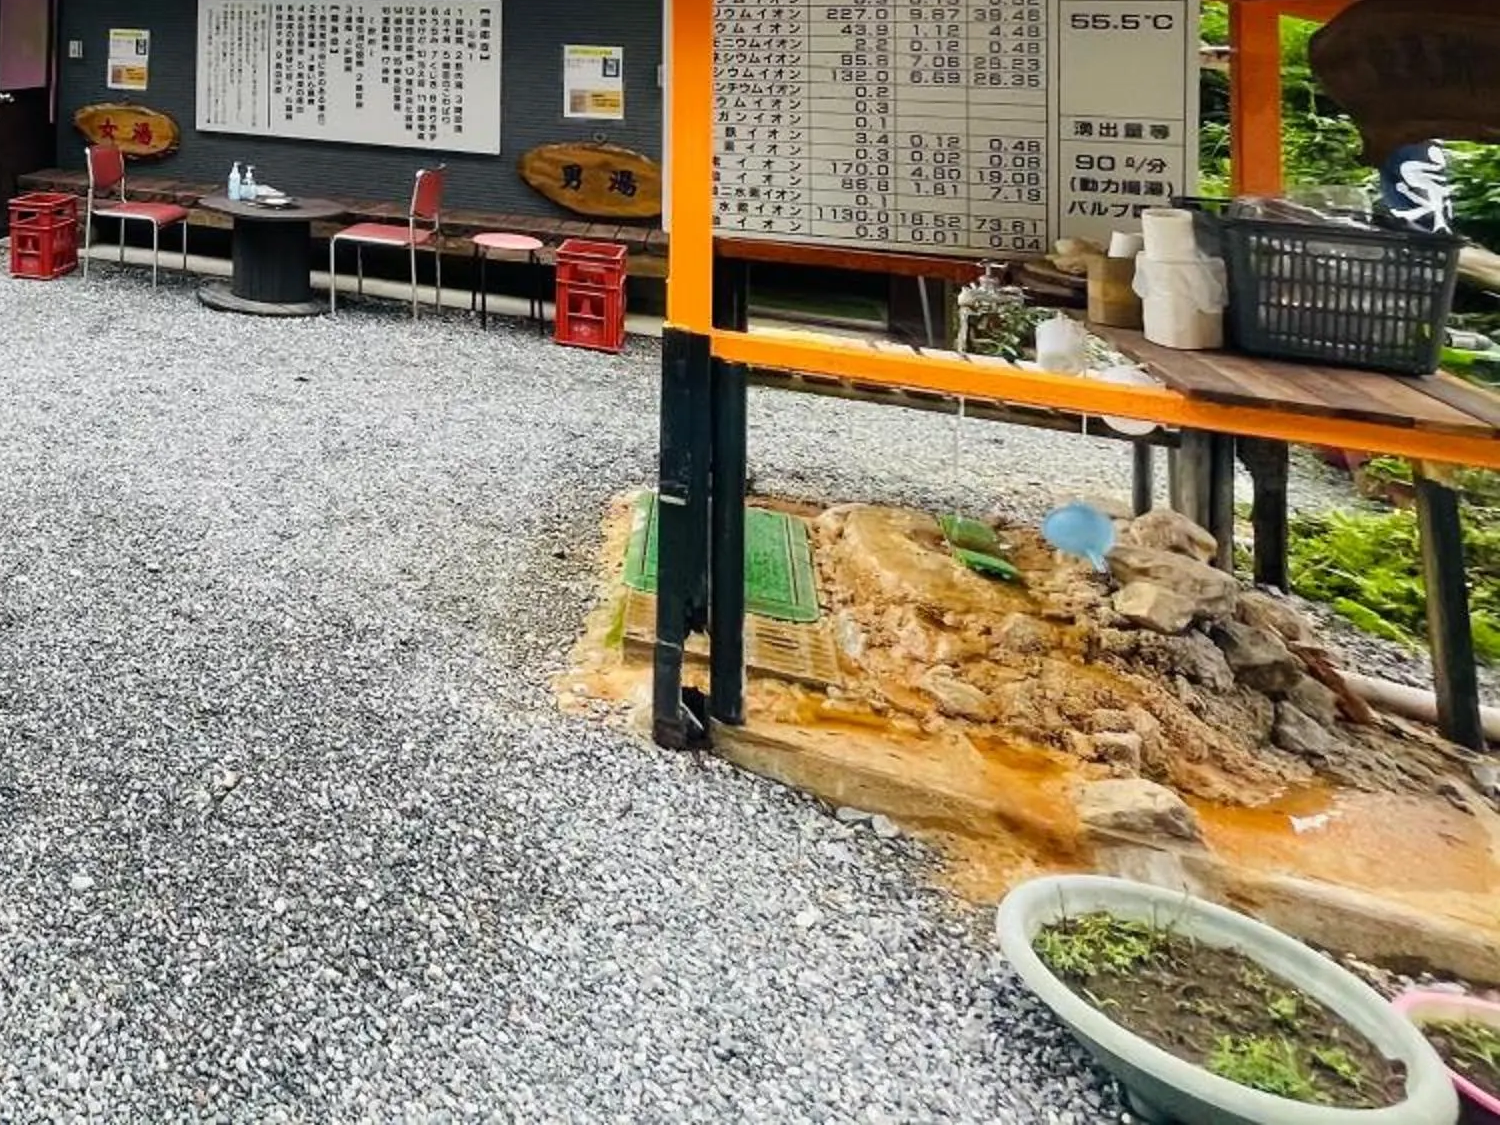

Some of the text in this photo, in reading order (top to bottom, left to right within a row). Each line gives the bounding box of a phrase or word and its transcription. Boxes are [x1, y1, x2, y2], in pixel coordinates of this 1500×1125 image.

[827, 9, 888, 20] 227.0
[910, 9, 960, 20] 9.87
[974, 9, 1039, 21] 39.46
[841, 25, 888, 35] 43.9
[913, 25, 958, 36] 1.12
[989, 25, 1039, 37] 4.48
[856, 39, 888, 51] 2.2
[910, 41, 958, 52] 0.12
[989, 42, 1039, 54] 0.48
[841, 55, 888, 67] 85.8
[911, 56, 960, 67] 7.06
[832, 69, 888, 82] 132.0
[855, 87, 888, 98] 0.2
[855, 101, 888, 113] 0.3
[856, 117, 887, 128] 0.1
[98, 118, 153, 145] 女湯
[856, 133, 888, 144] 3.4
[910, 135, 959, 147] 0.12
[990, 139, 1040, 152] 0.48
[856, 148, 888, 161] 0.3
[911, 151, 960, 163] 0.02
[990, 155, 1040, 168] 0.08
[1076, 155, 1115, 170] 90
[560, 163, 637, 197] 男湯
[831, 163, 889, 175] 170.0
[978, 171, 1039, 185] 19.08
[856, 195, 887, 207] 0.1
[990, 187, 1040, 201] 7.19
[818, 207, 888, 223] 1130.0
[900, 213, 960, 227] 18.52
[856, 225, 888, 239] 0.3
[912, 230, 958, 243] 0.01
[990, 235, 1040, 249] 0.04
